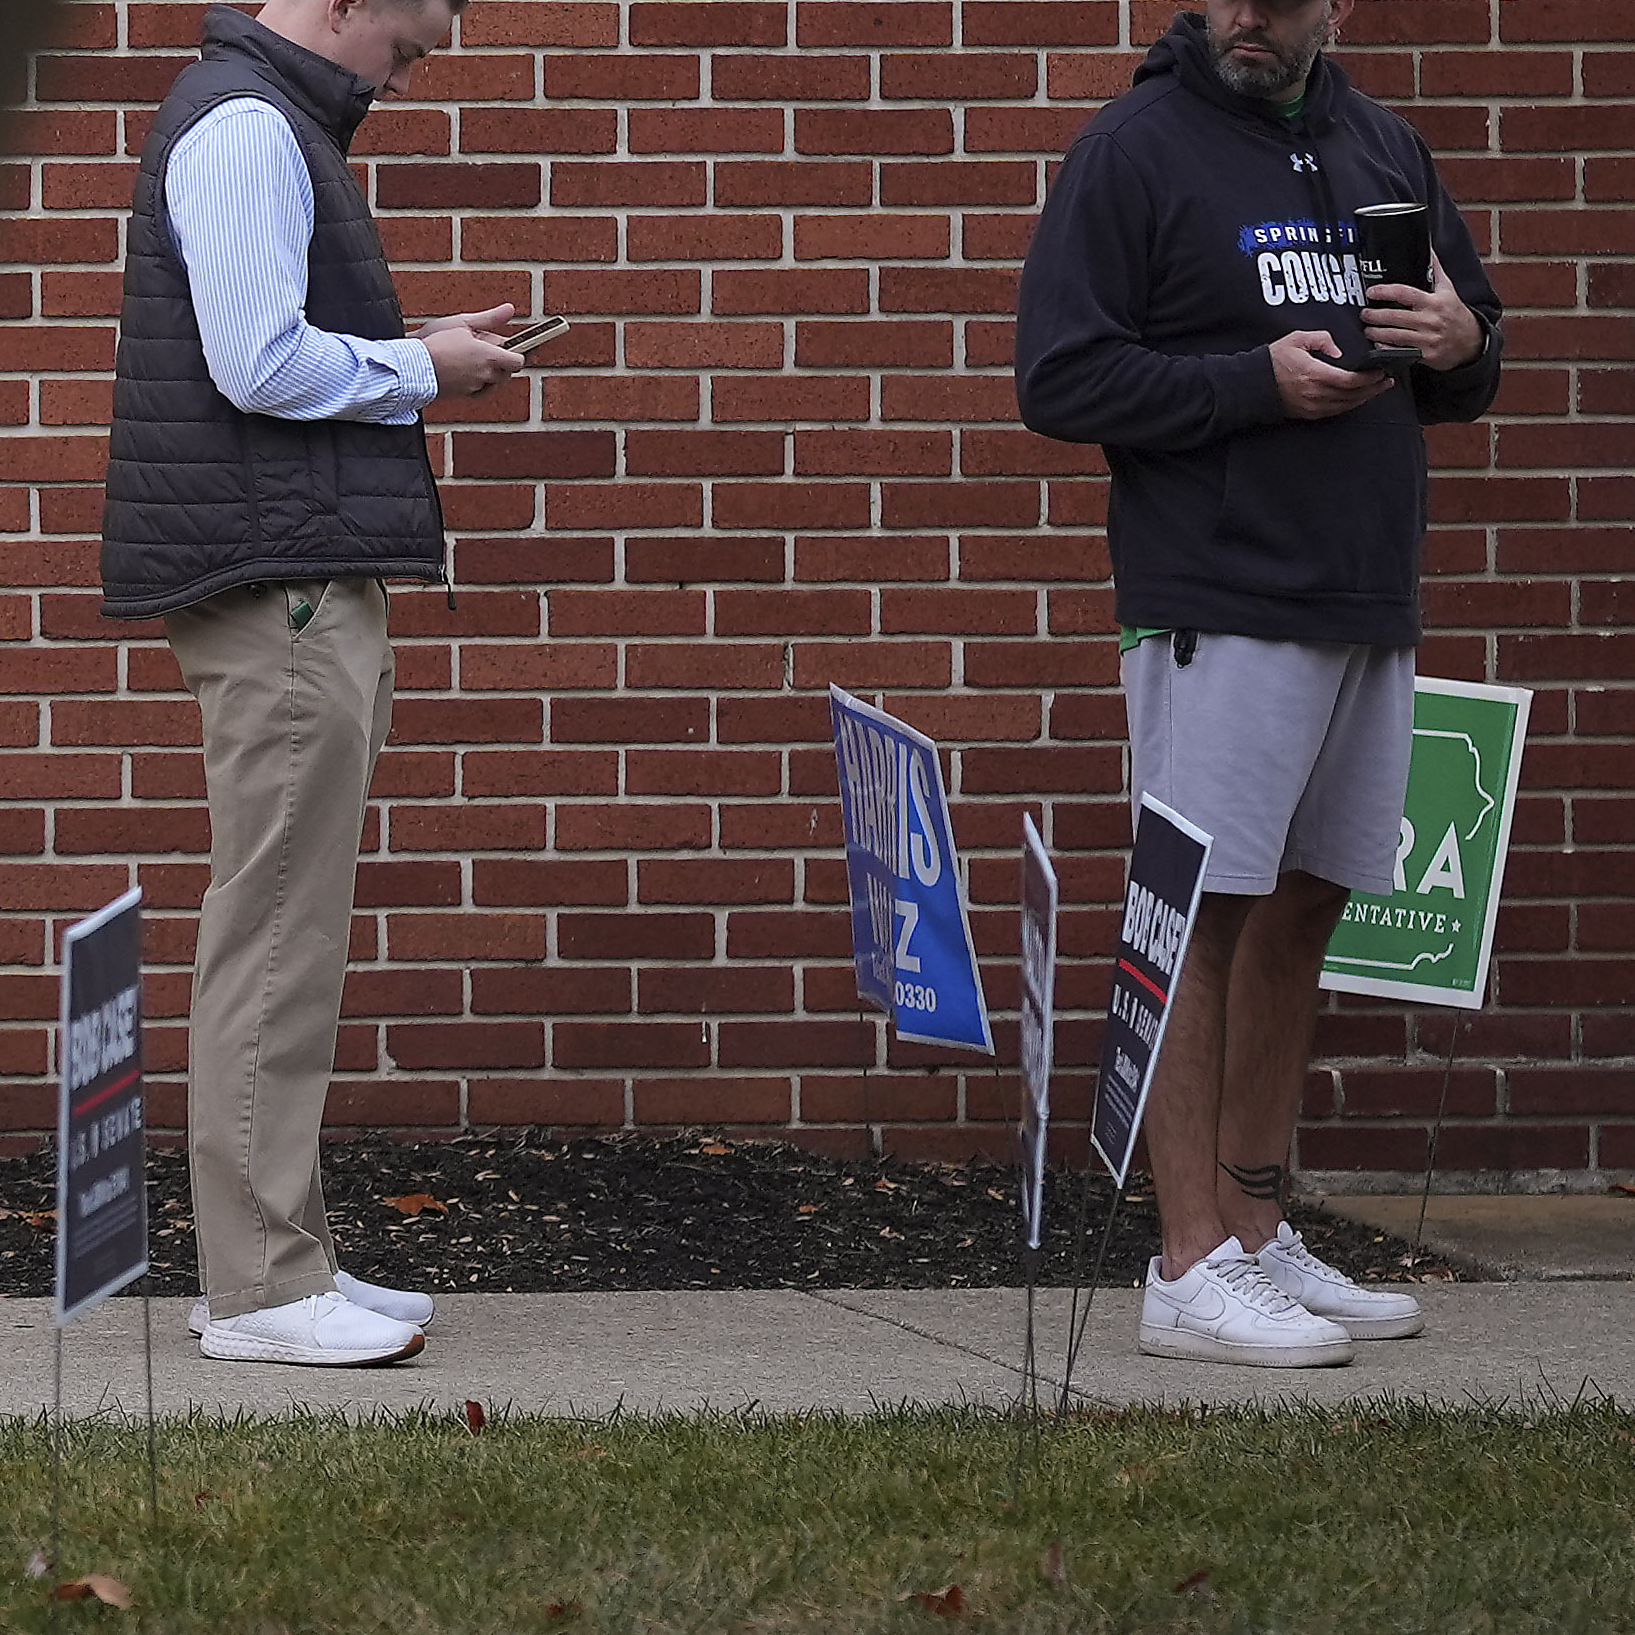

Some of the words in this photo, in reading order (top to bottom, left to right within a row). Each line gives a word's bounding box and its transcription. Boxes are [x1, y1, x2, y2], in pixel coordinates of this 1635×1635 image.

[1257, 251, 1366, 306] COUGA
[838, 712, 941, 887] HARRIS
[1122, 880, 1155, 955] BOB
[1148, 898, 1187, 976] CASE
[1341, 902, 1447, 933] ENTATIVE
